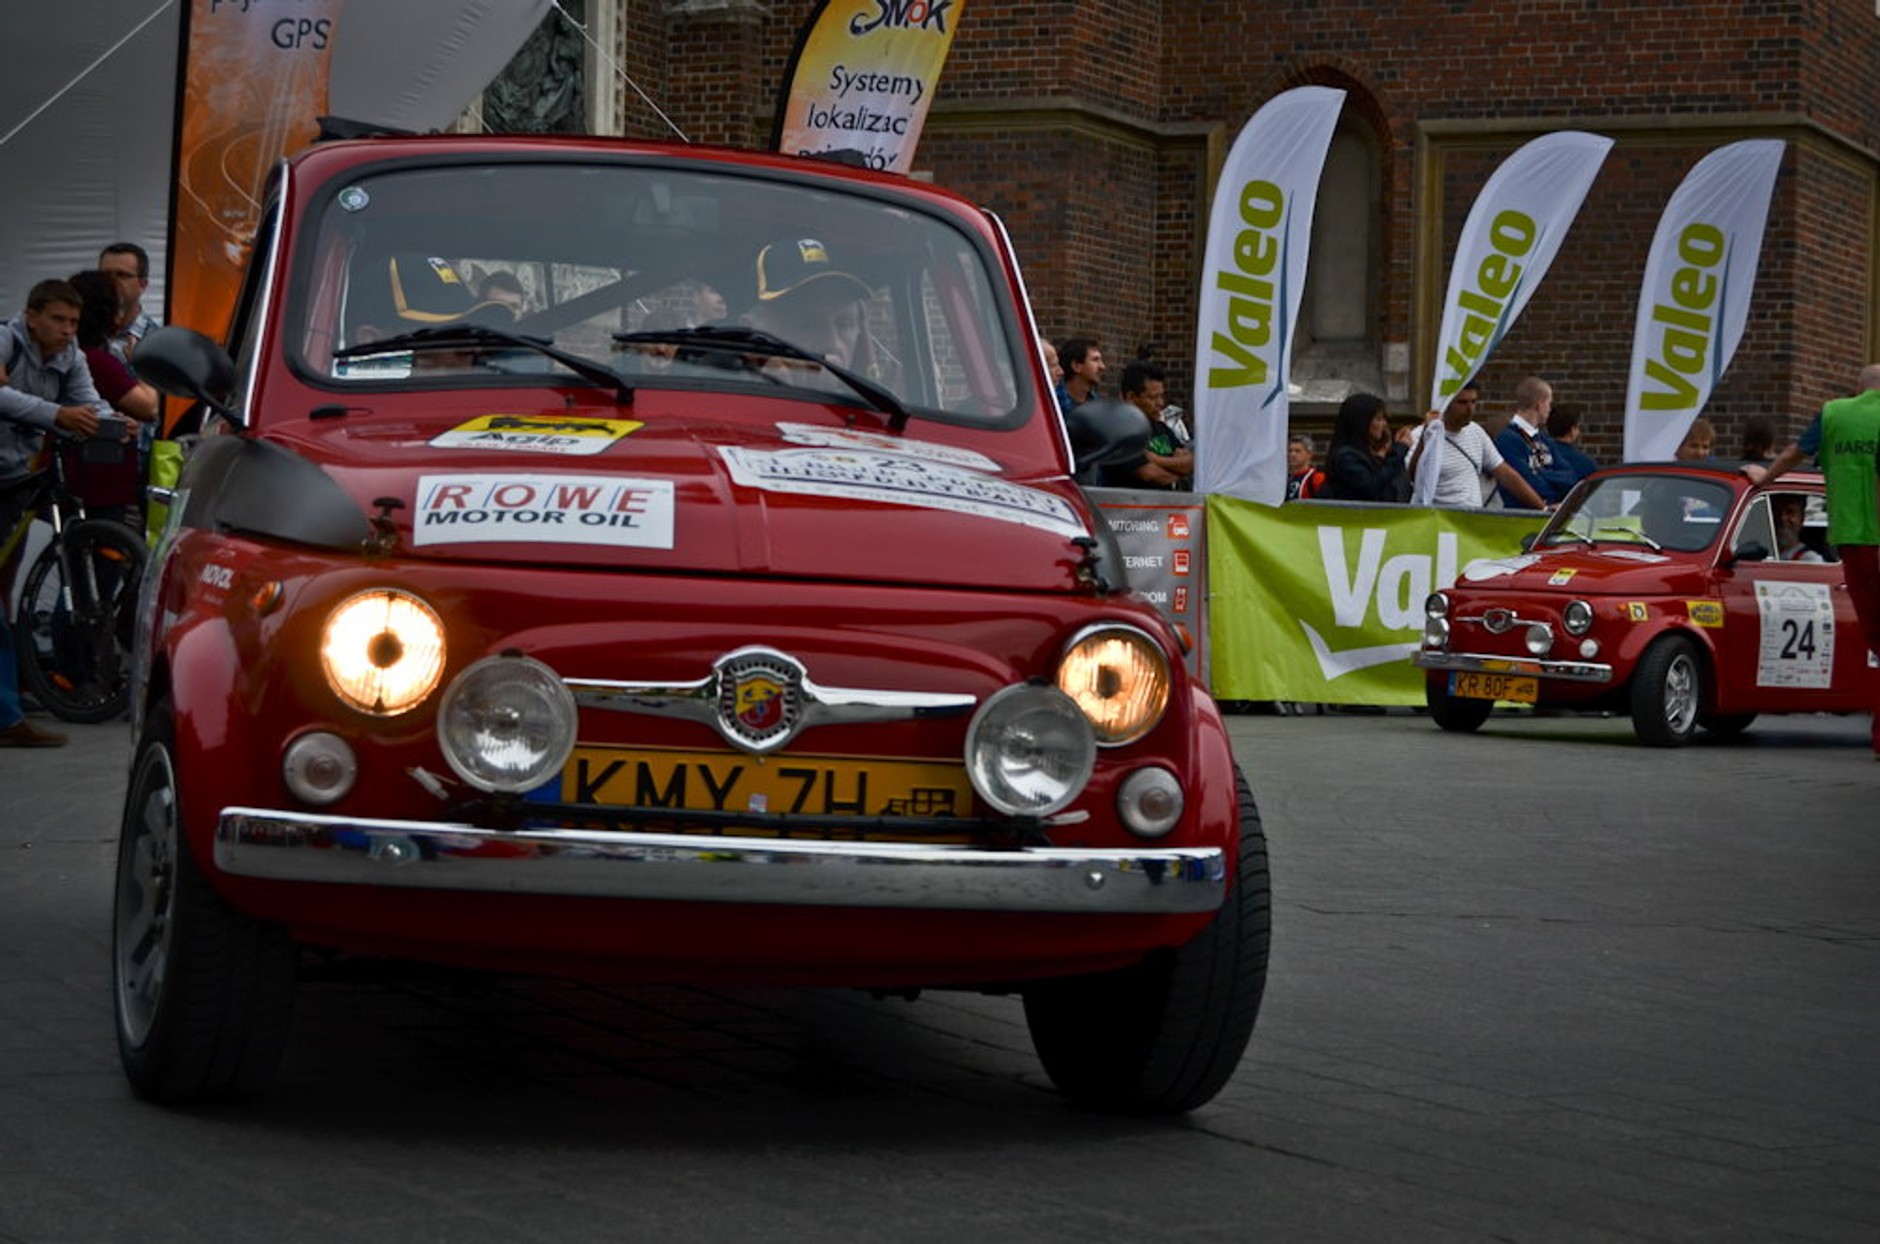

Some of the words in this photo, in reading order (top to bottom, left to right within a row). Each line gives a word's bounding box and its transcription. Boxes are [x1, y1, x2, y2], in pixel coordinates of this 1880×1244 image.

[271, 18, 331, 49] GPS
[829, 65, 924, 105] Systemy
[1208, 179, 1284, 389] Valeo
[1440, 209, 1536, 396] Valeo
[1639, 222, 1724, 411] Valeo
[469, 432, 580, 446] Agip
[425, 509, 565, 526] MOTOR
[580, 512, 641, 528] OIL
[431, 484, 653, 513] ROWE
[1780, 619, 1815, 660] 24
[1457, 673, 1478, 693] KR
[576, 758, 744, 820] KMY
[778, 767, 867, 826] 7H
